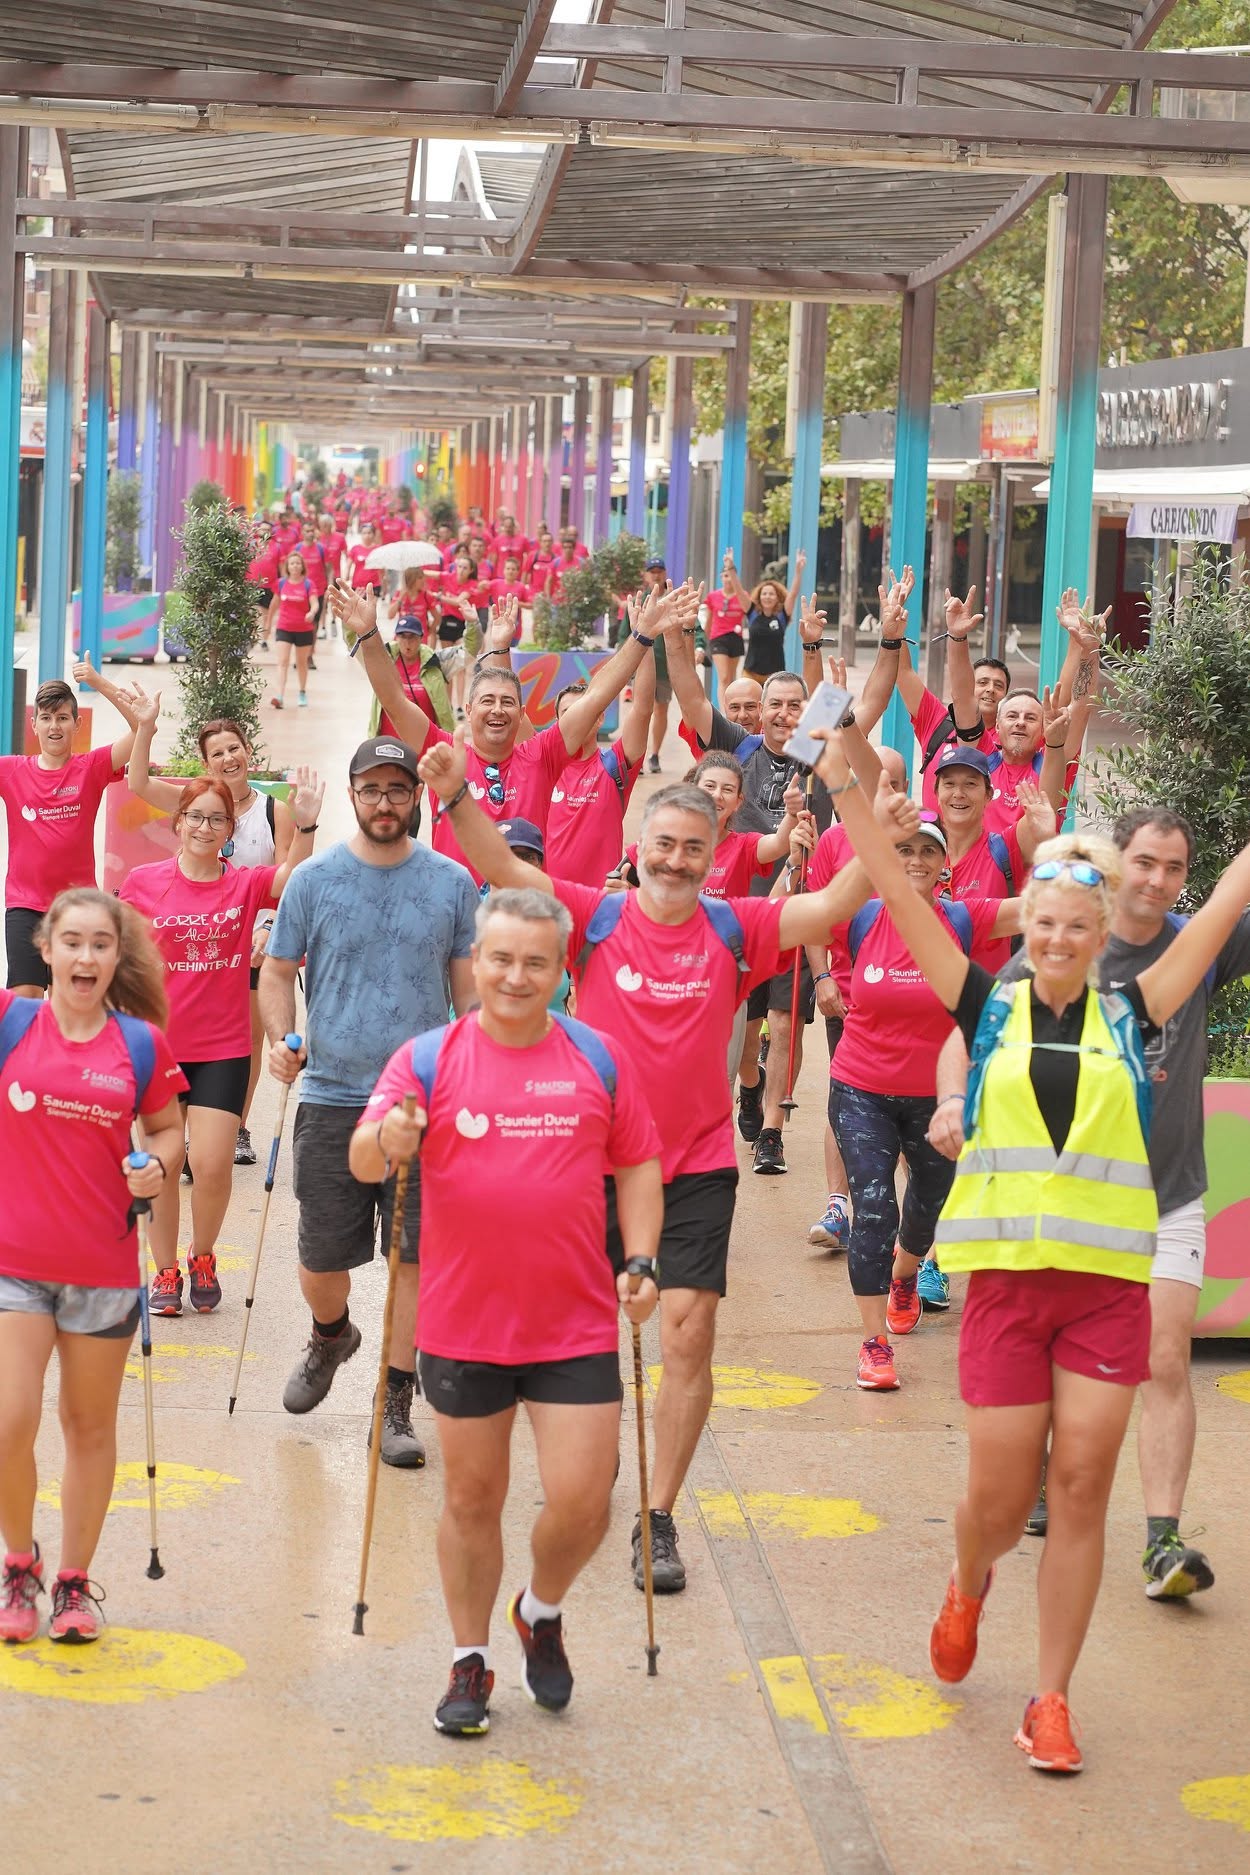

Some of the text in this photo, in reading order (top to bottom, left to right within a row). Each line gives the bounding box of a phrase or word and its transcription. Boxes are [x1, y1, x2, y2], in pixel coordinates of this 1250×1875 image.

[38, 803, 81, 815] Saunier Duval
[705, 887, 726, 895] Duval
[153, 913, 209, 928] CORRE
[167, 958, 229, 972] VEHINTER
[888, 968, 921, 976] Saunier
[646, 978, 710, 992] Saunier Duval
[650, 989, 678, 999] Siempre
[42, 1094, 122, 1121] Saunier Duval
[494, 1112, 579, 1127] Saunier Duval
[500, 1128, 536, 1139] Siempre
